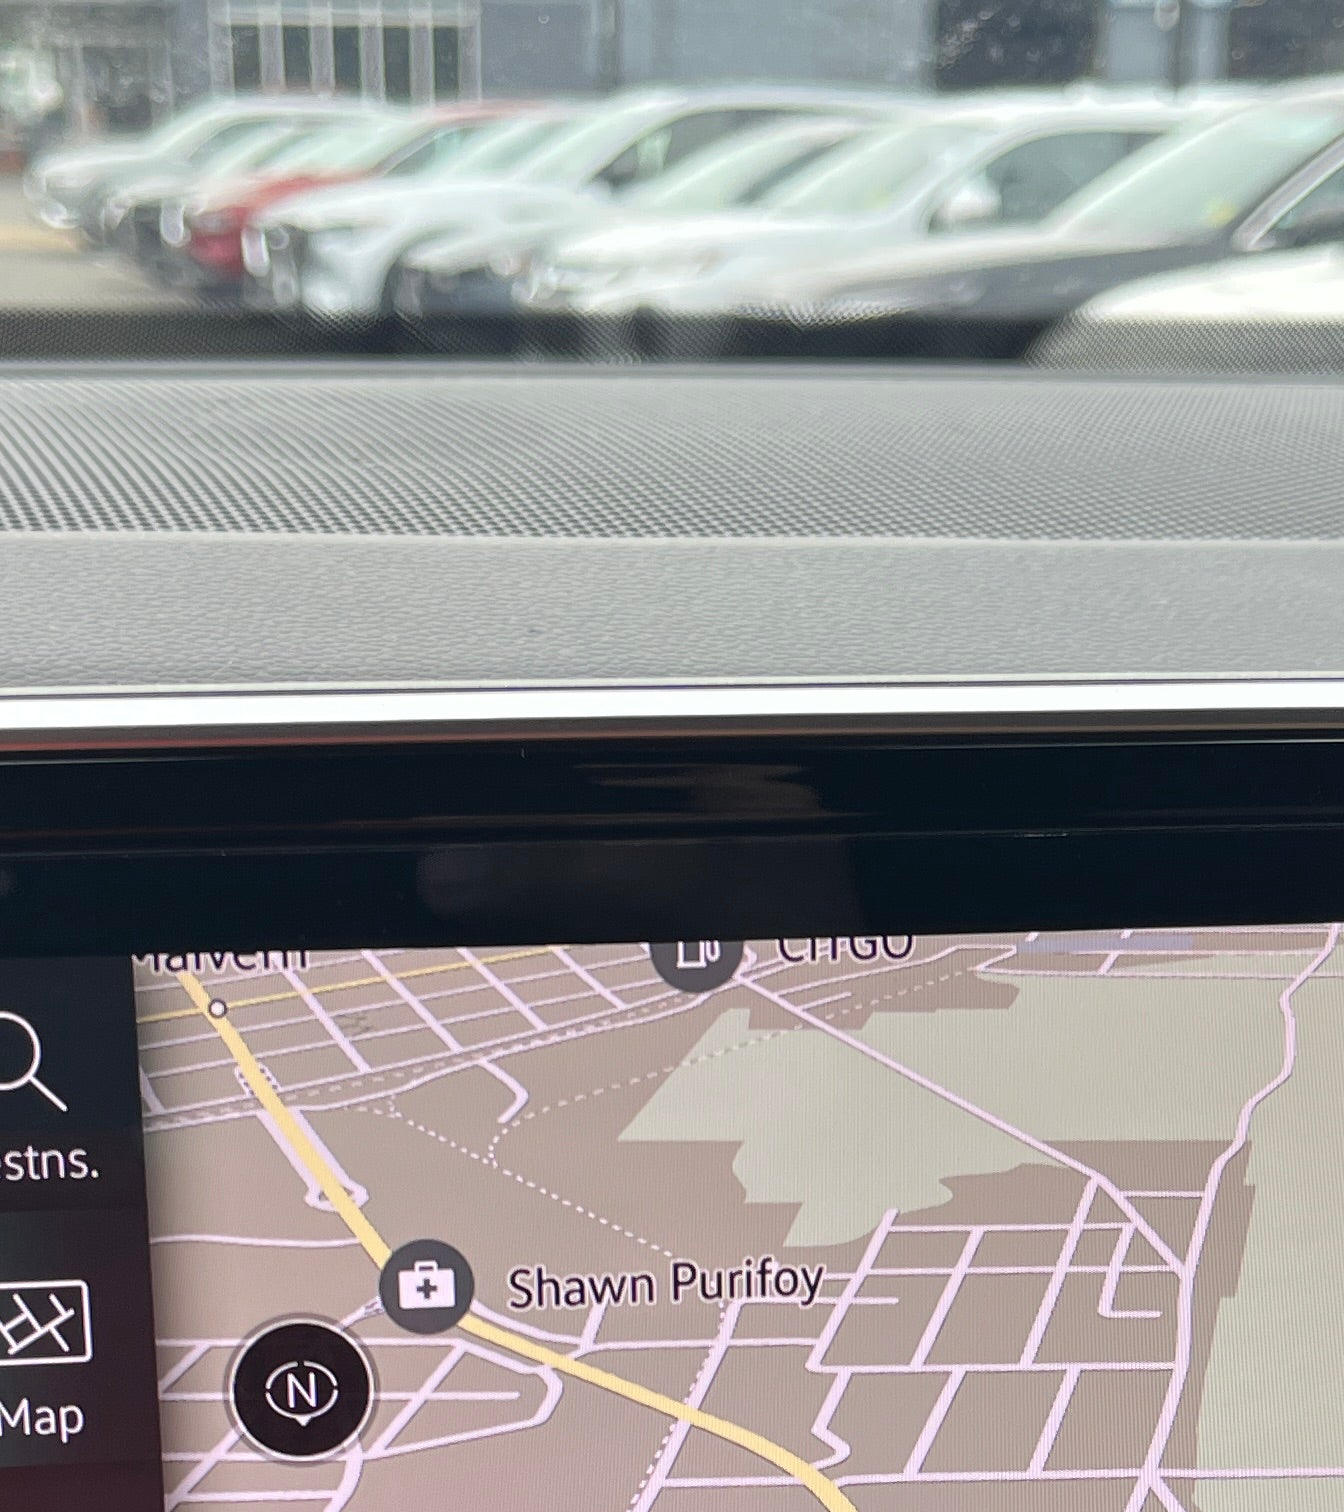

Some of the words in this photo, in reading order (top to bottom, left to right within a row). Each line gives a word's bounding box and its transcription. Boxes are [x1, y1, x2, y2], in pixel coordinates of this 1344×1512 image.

[506, 1264, 655, 1308] Shawn
[669, 1256, 826, 1308] Purifoy
[286, 1370, 318, 1409] N
